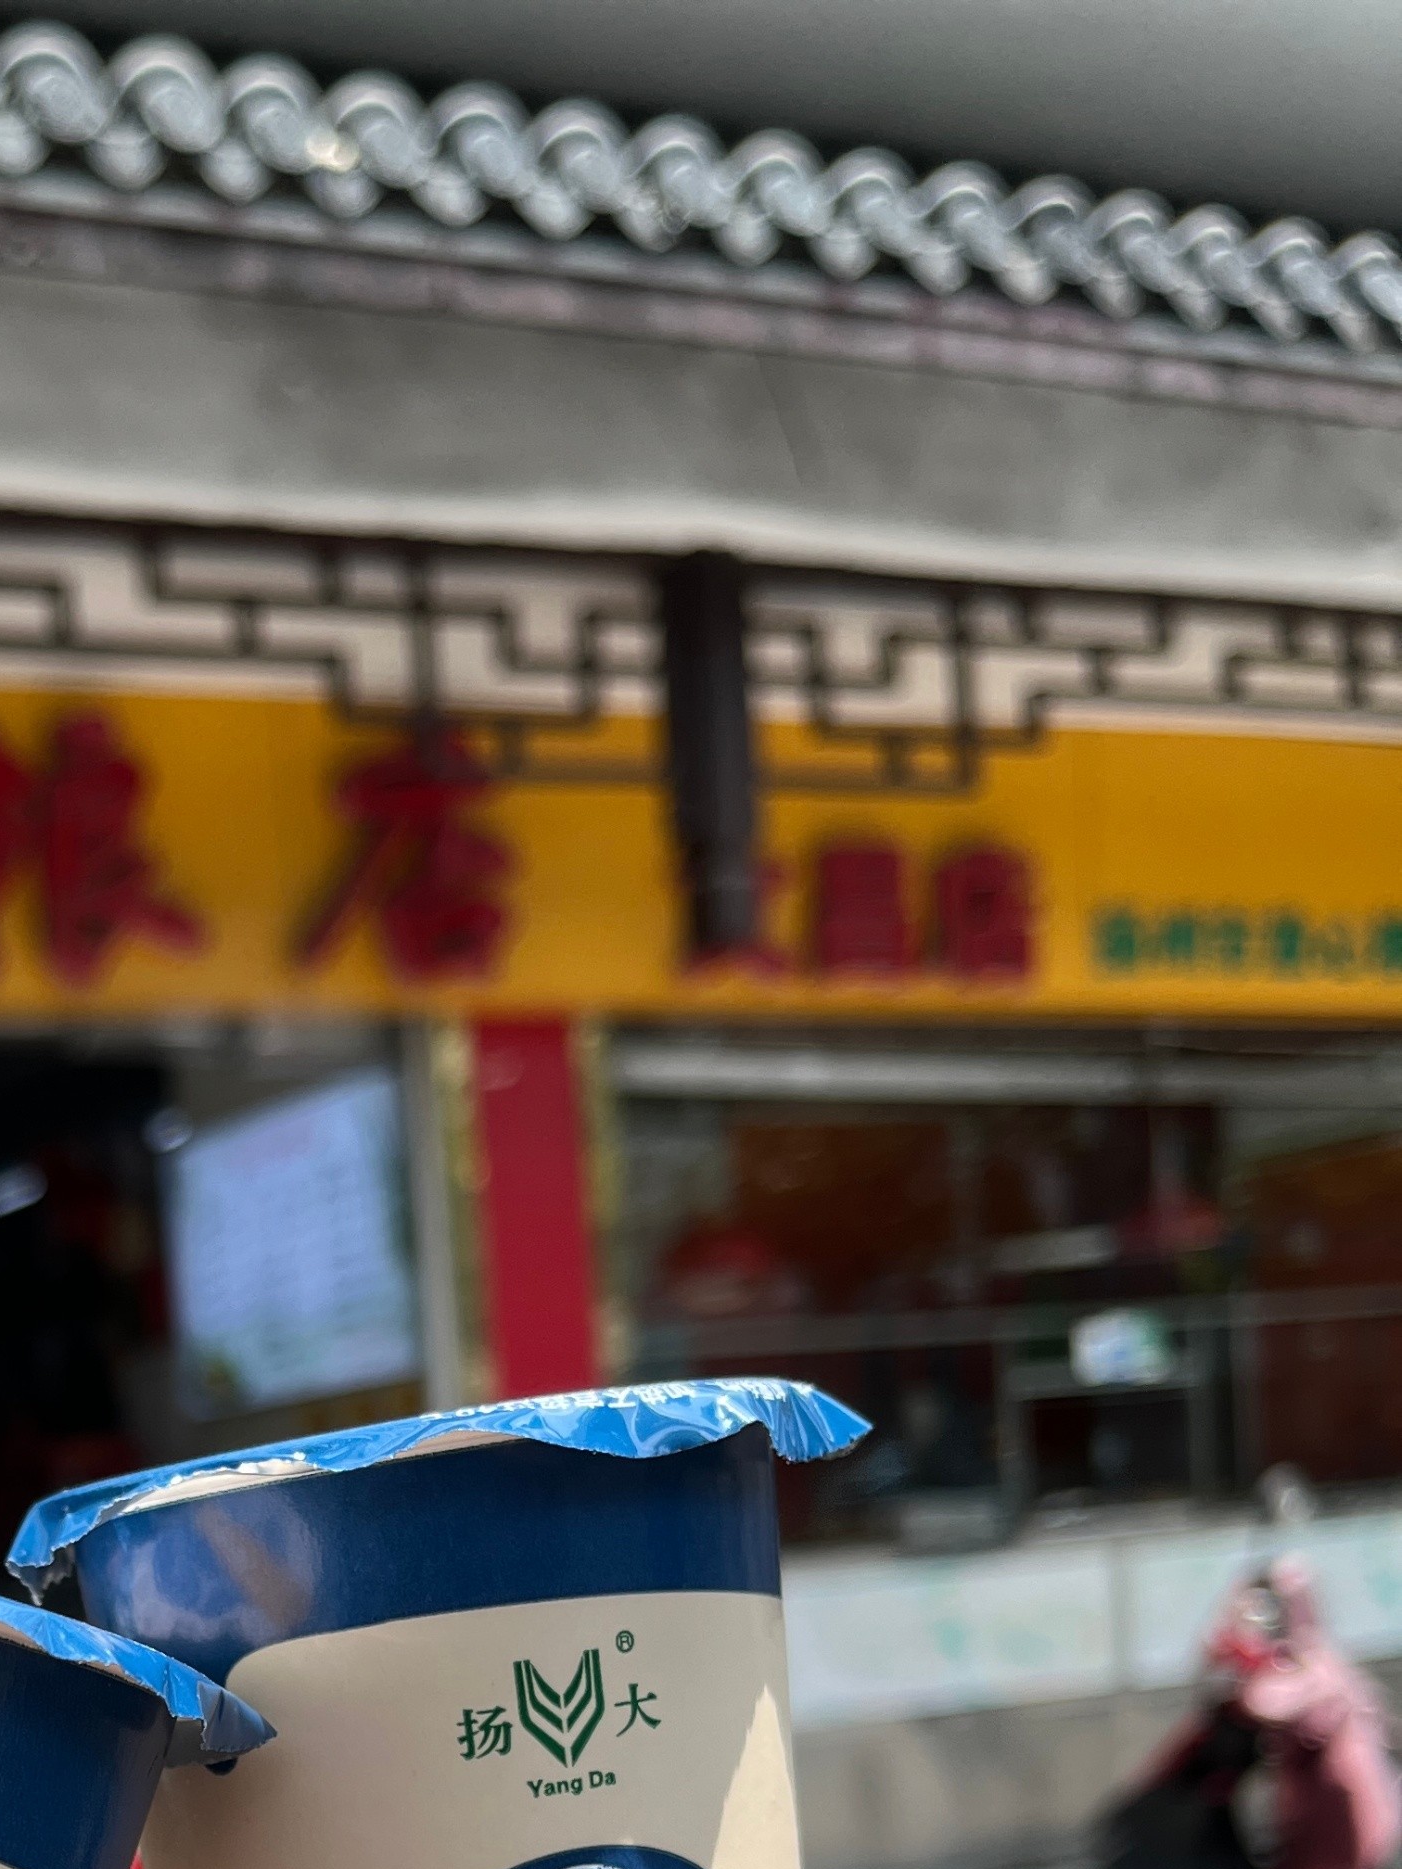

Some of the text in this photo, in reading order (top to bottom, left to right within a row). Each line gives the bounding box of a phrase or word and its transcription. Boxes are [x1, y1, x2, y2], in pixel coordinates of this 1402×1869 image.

[456, 1682, 663, 1762] 扬 大
[527, 1768, 617, 1800] Yang Da
